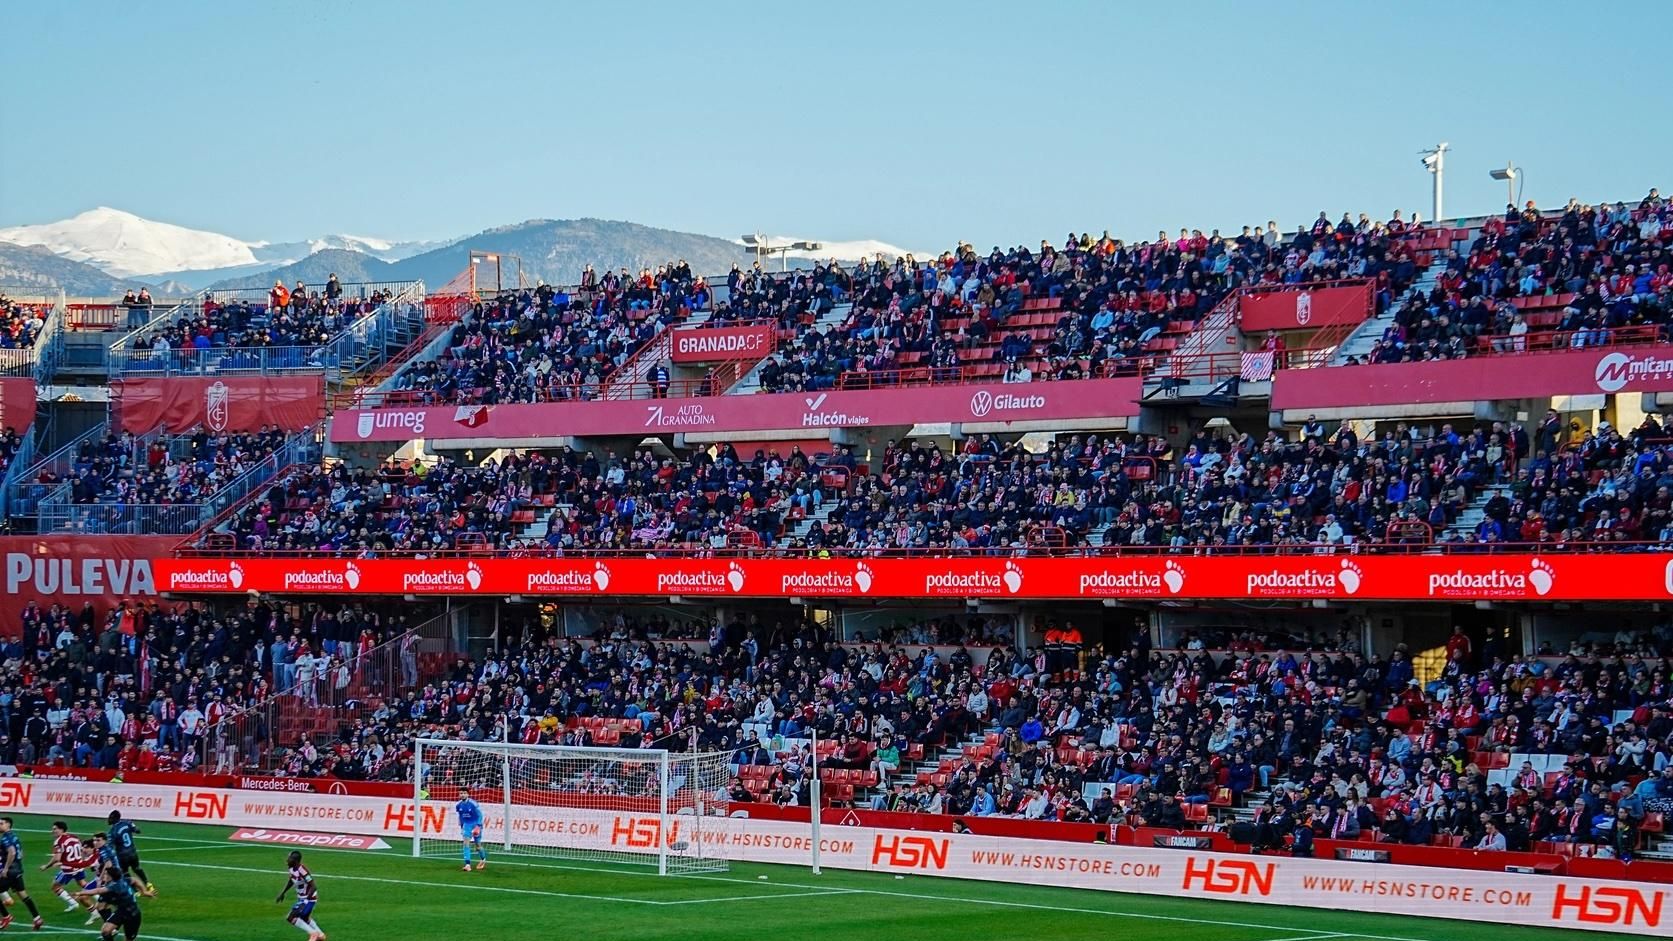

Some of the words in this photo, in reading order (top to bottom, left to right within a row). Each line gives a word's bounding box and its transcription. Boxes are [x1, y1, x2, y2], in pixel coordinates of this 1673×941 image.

[677, 405, 703, 415] AUTO
[994, 394, 1045, 410] Gilauto
[375, 411, 426, 434] umeg
[661, 414, 715, 426] GRANADINA
[802, 411, 847, 427] Halcón
[847, 415, 869, 426] viajes
[7, 552, 157, 595] PULEVA
[171, 569, 227, 588] podoactiva
[285, 569, 343, 589] podoactiva
[404, 569, 464, 590] podoactiva
[528, 570, 591, 591] podoactiva
[658, 570, 725, 591] podoactiva
[783, 570, 852, 593] podoactiva
[926, 570, 1001, 593] podoactiva
[1080, 570, 1161, 594] podoactiva
[1247, 570, 1335, 594] podoactiva
[1429, 570, 1526, 595] podoactiva
[241, 776, 310, 792] Mercedes-Benz
[121, 832, 132, 847] 9
[273, 831, 364, 847] mapfre
[0, 782, 32, 808] SN
[46, 792, 162, 809] WWW.HSNSTORE.COM
[174, 792, 229, 819] HSN
[244, 803, 374, 822] WWW.HSNSTORE.COM
[484, 816, 600, 836] W.HNSTORE.COM
[690, 831, 854, 854] WWW.HSNSTORECOM
[872, 834, 950, 870] HSN
[971, 850, 1161, 878] WWW.HSNSTORE.COM
[1182, 856, 1275, 896] HSN
[1302, 875, 1532, 906] WWW.HSNSTORE.COM
[1552, 883, 1664, 927] HSN
[66, 844, 82, 862] 20
